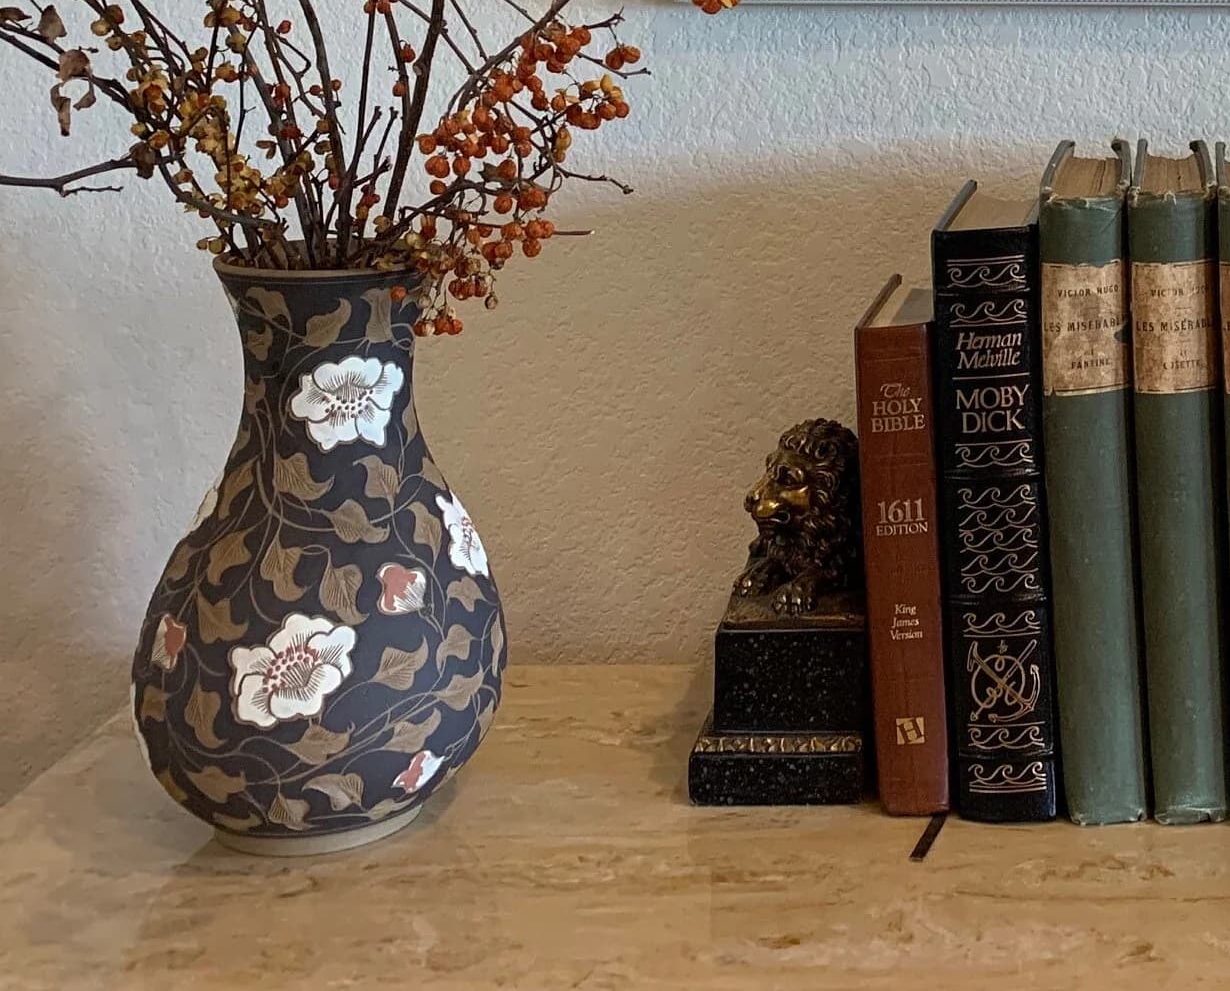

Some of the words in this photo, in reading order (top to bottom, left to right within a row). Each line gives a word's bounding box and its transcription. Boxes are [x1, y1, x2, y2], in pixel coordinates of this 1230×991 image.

[1150, 287, 1185, 297] VICOR
[1136, 321, 1154, 332] LES
[954, 331, 1022, 352] Herman
[956, 350, 1022, 371] Melville
[872, 397, 923, 417] HOLY
[955, 383, 1030, 411] MOBY
[871, 414, 926, 434] BIBLE
[962, 410, 1026, 435] DICK
[877, 497, 926, 525] 1611
[876, 521, 929, 537] EDITION
[894, 603, 918, 616] King
[891, 617, 920, 629] James
[890, 629, 924, 642] Version
